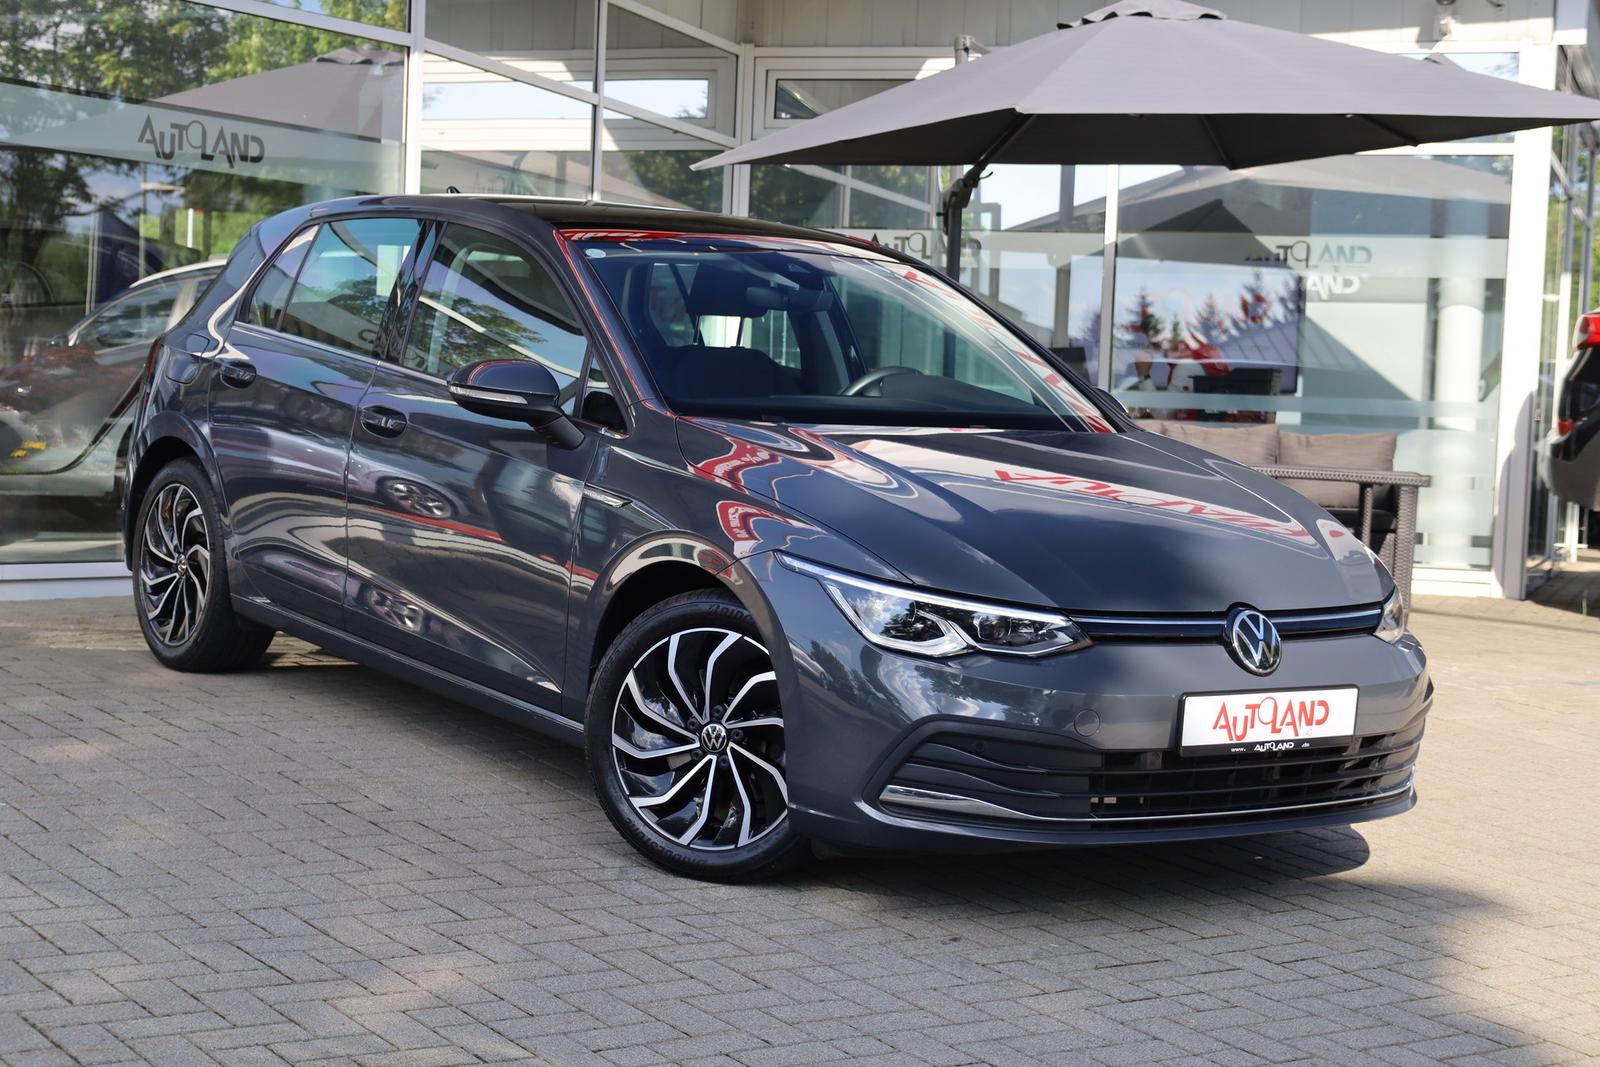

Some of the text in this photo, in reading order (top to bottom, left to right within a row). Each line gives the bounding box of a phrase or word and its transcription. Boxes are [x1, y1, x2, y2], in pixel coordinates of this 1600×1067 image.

[137, 114, 265, 169] AUTOLAND
[1245, 240, 1373, 272] TOLAND
[1212, 696, 1330, 742] AUTOLAND
[1254, 742, 1295, 752] AUTOLAND
